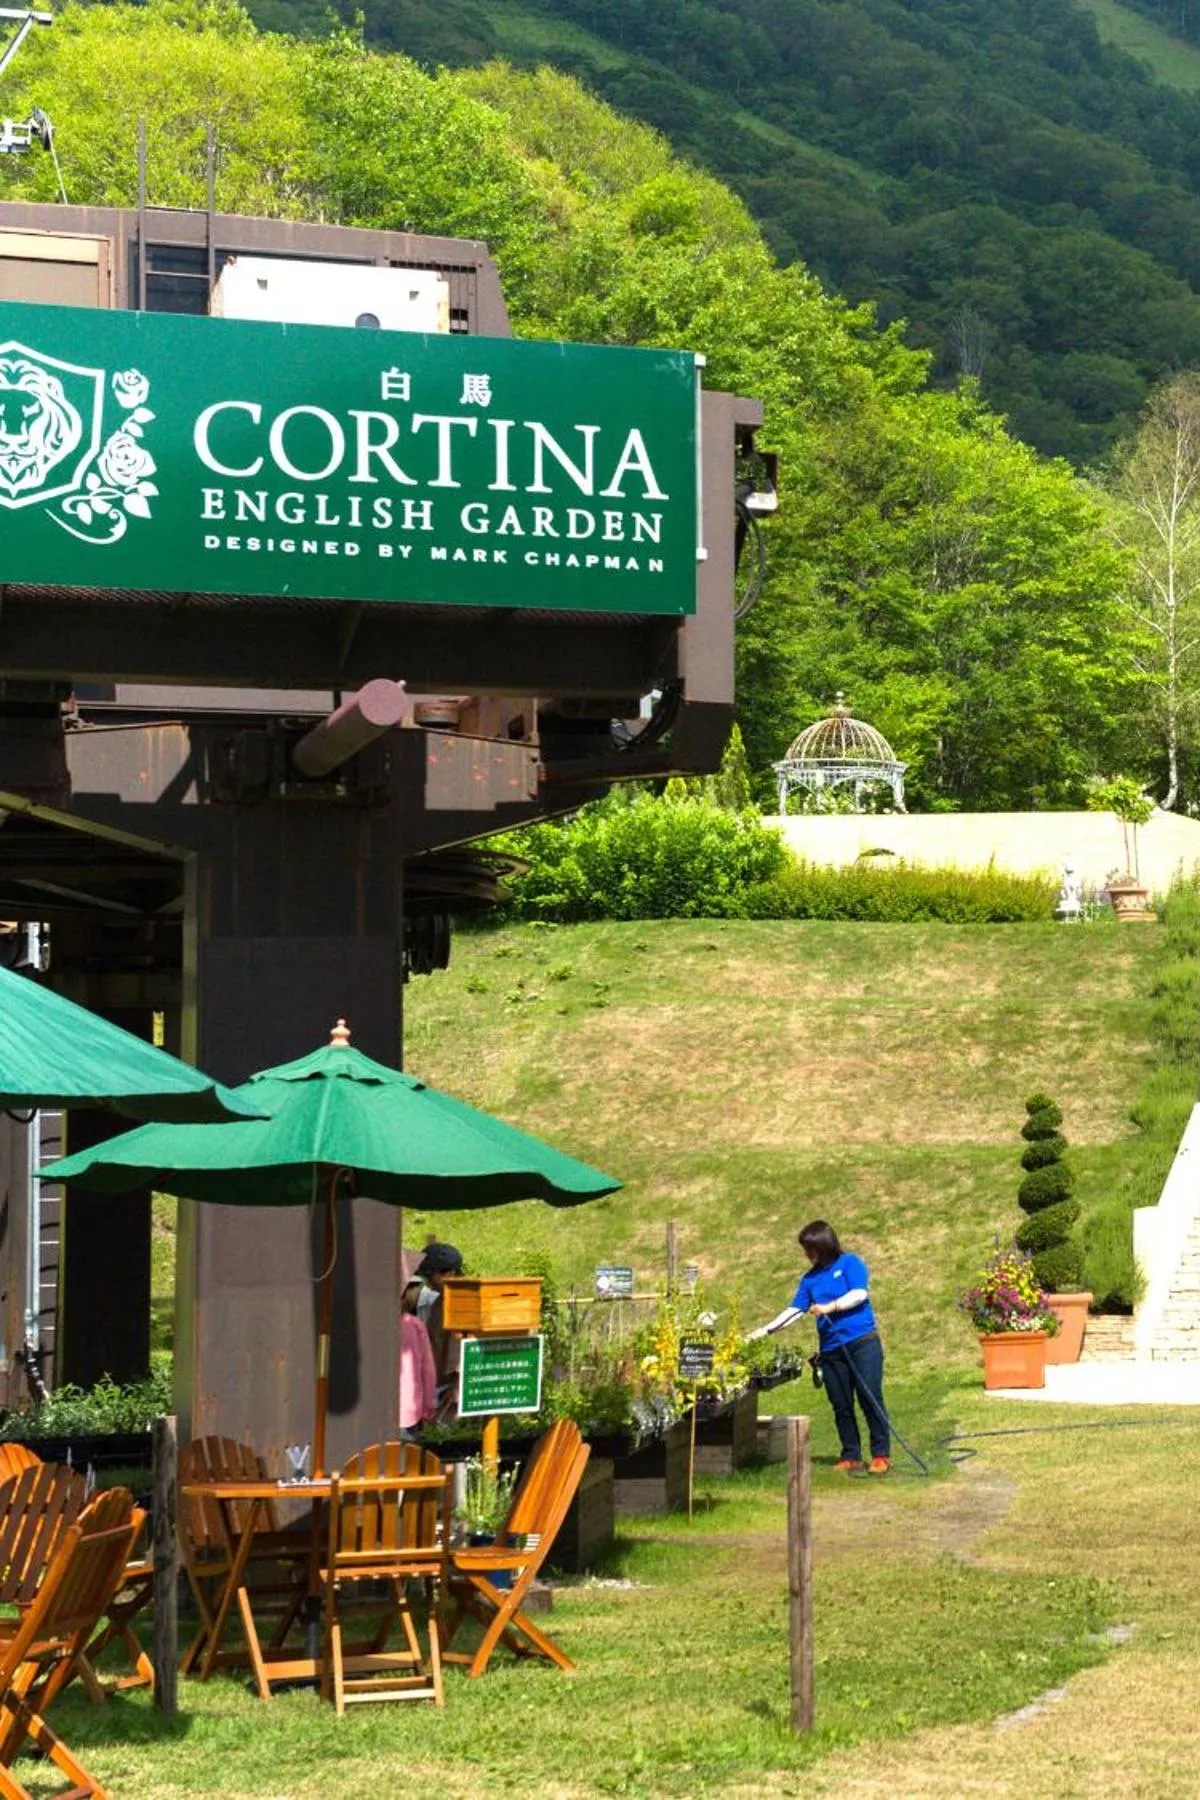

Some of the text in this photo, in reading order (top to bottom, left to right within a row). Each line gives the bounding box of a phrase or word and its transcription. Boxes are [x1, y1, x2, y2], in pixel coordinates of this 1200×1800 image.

[193, 400, 669, 500] CORTINA
[201, 488, 663, 543] ENGLISH GARDEN
[204, 535, 664, 572] DESIGNED BY MARK CHAPMAN
